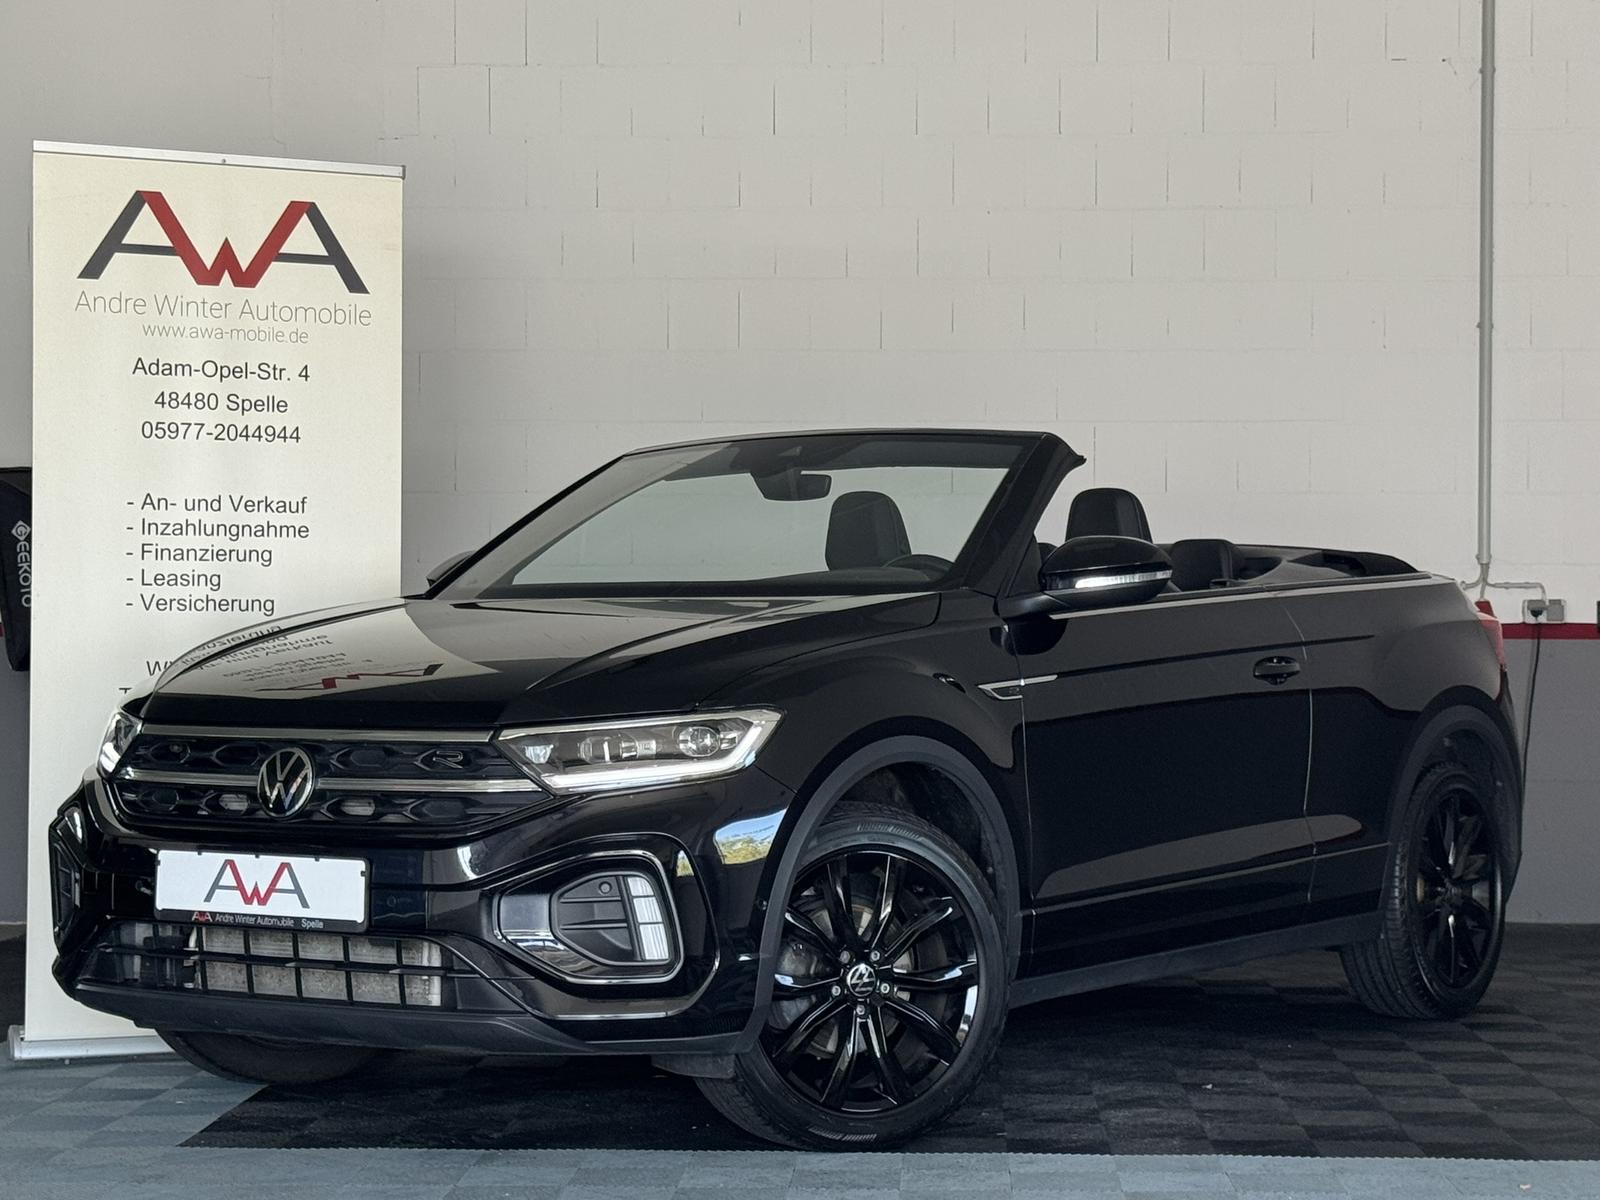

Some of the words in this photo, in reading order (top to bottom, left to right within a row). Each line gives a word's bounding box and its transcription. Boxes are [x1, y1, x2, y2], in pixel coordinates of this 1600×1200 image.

[76, 190, 371, 294] AWA
[75, 290, 146, 315] Andre
[154, 294, 232, 319] Winter
[239, 301, 372, 327] Automobile
[142, 324, 309, 344] www.awa-mobile.de
[132, 357, 290, 383] Adam-Opel-Str.
[298, 365, 310, 381] 4
[154, 391, 218, 410] 48480
[226, 394, 288, 416] Spelle
[142, 421, 301, 443] 05977-2044944
[141, 493, 176, 511] An-
[185, 495, 221, 512] und
[229, 495, 307, 514] Verkauf
[142, 518, 309, 542] Inzahlungnahme
[141, 543, 273, 568] Finanzierung
[142, 568, 220, 591] Leasing
[140, 594, 274, 617] Versicherung
[203, 858, 311, 909] AWA
[215, 913, 235, 924] Andre
[235, 914, 256, 925] Winter
